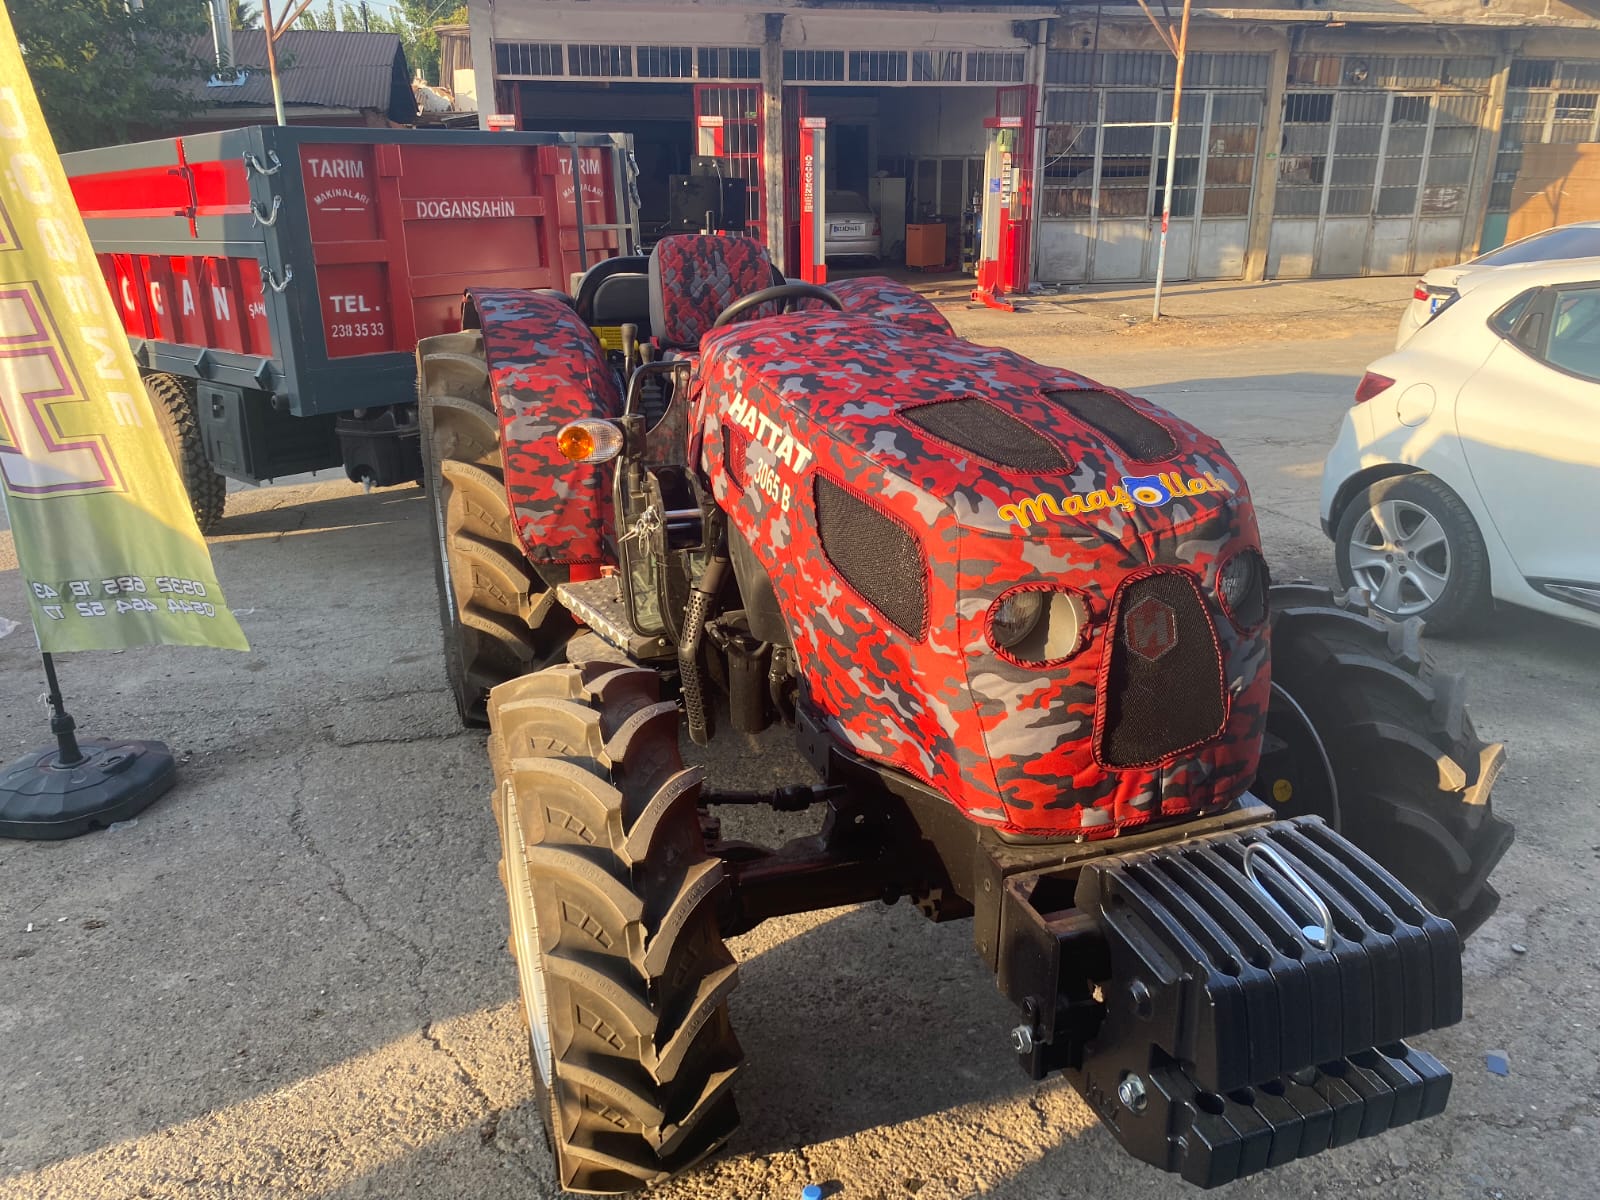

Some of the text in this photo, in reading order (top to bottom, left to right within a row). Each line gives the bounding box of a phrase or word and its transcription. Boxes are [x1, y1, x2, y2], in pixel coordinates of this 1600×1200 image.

[308, 158, 364, 179] TARIM
[313, 188, 370, 206] MAKINALARI
[331, 323, 384, 338] 238 35 33
[728, 392, 812, 474] HATTAT
[754, 457, 791, 513] 3065 B
